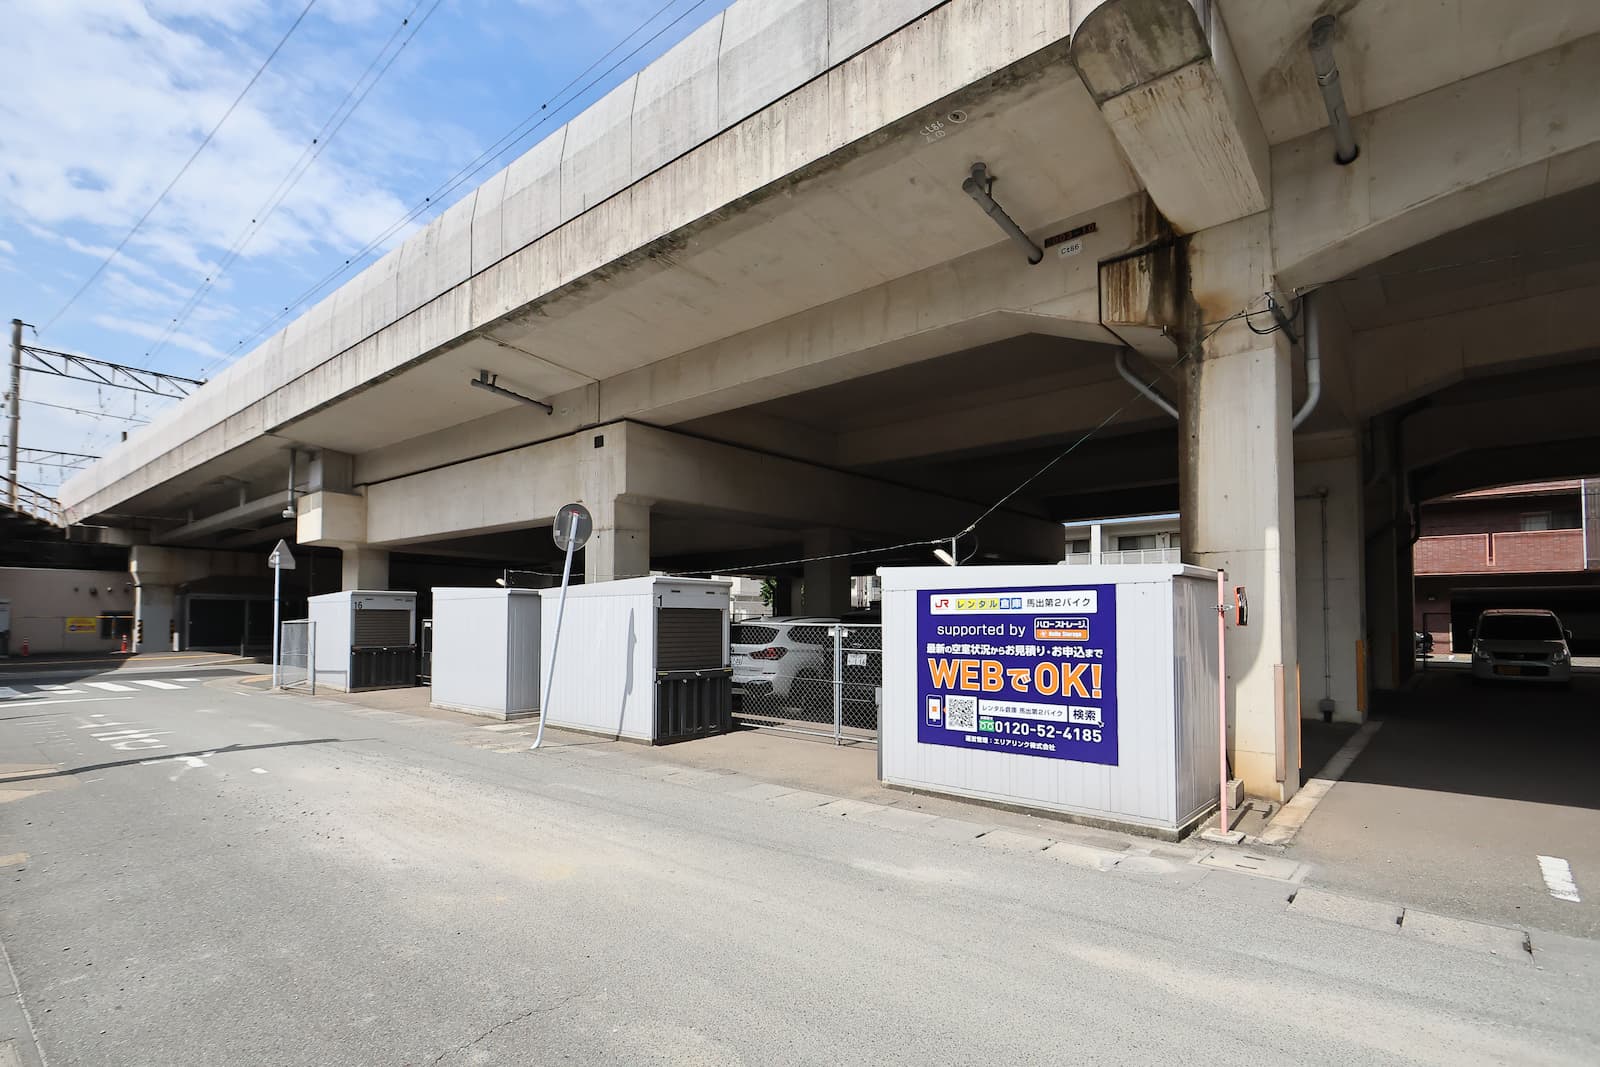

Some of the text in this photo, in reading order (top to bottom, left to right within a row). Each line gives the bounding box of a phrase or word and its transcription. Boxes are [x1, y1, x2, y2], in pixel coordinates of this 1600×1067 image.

[935, 599, 949, 608] JR
[937, 624, 1026, 637] supported by
[1073, 709, 1097, 721] 検索
[995, 720, 1102, 743] 0120-52-4185
